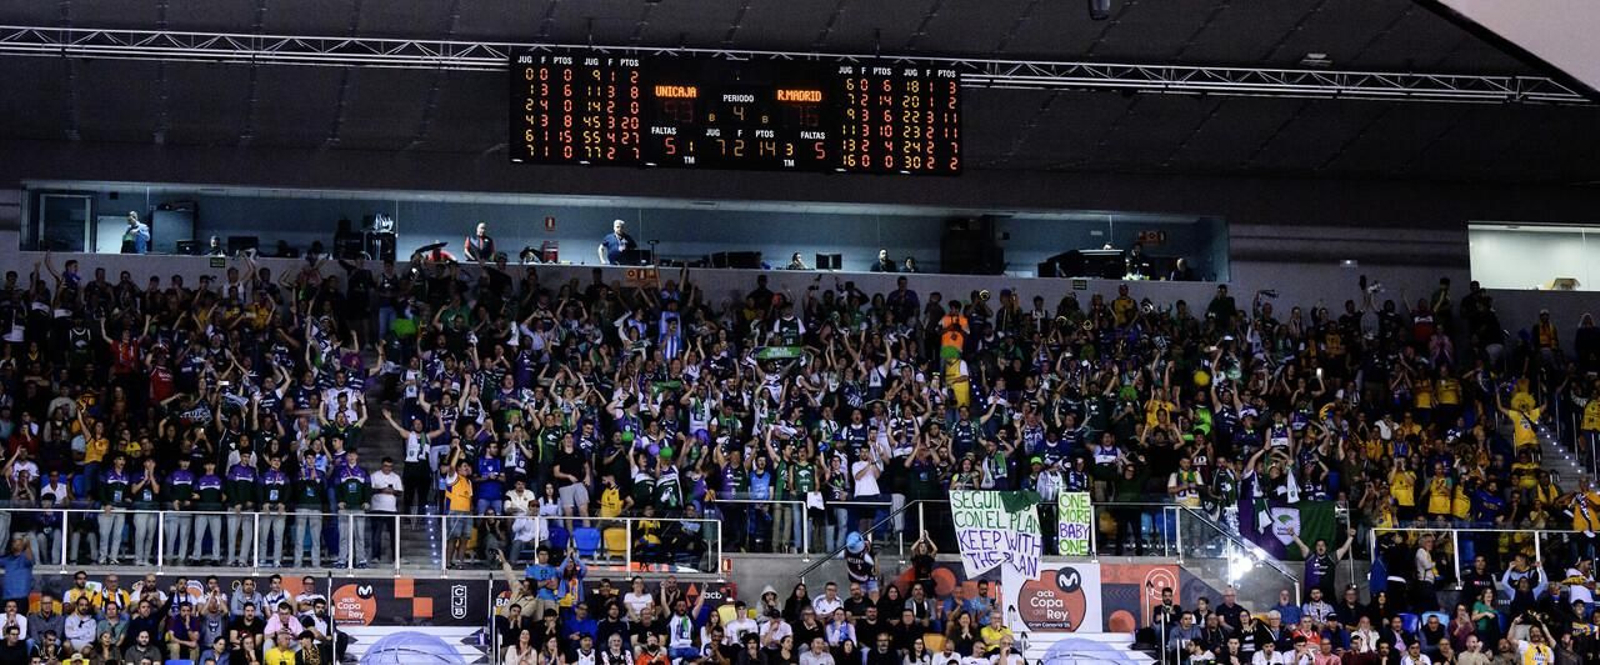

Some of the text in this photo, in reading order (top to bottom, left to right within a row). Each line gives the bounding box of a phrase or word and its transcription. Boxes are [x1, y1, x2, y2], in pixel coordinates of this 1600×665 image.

[541, 56, 546, 64] F
[553, 57, 573, 65] PTOS
[608, 58, 613, 66] F
[526, 68, 534, 80] 0
[540, 68, 548, 80] 0
[564, 69, 572, 81] 0
[592, 69, 600, 81] 9
[631, 71, 639, 83] 2
[838, 66, 853, 74] JUG
[873, 67, 892, 75] PTOS
[938, 69, 957, 77] PTOS
[541, 83, 548, 96] 3
[564, 84, 572, 96] 6
[588, 85, 600, 96] 11
[608, 85, 615, 98] 3
[631, 86, 639, 99] 8
[655, 85, 697, 98] UNICAJA
[846, 78, 854, 90] 6
[860, 78, 868, 90] 0
[883, 79, 892, 91] 6
[906, 80, 920, 92] 18
[949, 81, 956, 94] 3
[723, 94, 755, 103] PERIODO
[777, 89, 822, 101] R.MADRID
[848, 93, 855, 104] 7
[860, 93, 869, 106] 2
[879, 95, 892, 106] 14
[902, 95, 920, 107] 20
[949, 97, 957, 109] 2
[526, 98, 639, 114] 2 4 0 14 2 0
[733, 106, 744, 120] 4
[526, 114, 639, 129] 4 3 8 45 3 20
[847, 108, 957, 123] 9 3 6 22 3 11
[526, 129, 534, 141] 6
[559, 130, 572, 143] 15
[583, 131, 600, 143] 55
[607, 132, 615, 143] 4
[621, 132, 639, 144] 27
[651, 126, 677, 135] FALTAS
[705, 128, 721, 136] JUG
[755, 130, 774, 138] PTOS
[801, 131, 826, 139] FALTAS
[843, 124, 957, 139] 11 3 10 23 2 11
[527, 144, 534, 156] 7
[564, 146, 572, 158] 0
[584, 146, 600, 157] 77
[607, 147, 615, 159] 2
[632, 147, 639, 159] 7
[665, 137, 676, 154] 5
[716, 139, 776, 156] 7 2 14
[785, 143, 793, 155] 3
[814, 142, 826, 159] 5
[843, 139, 958, 154] 13 2 4 24 2 7
[684, 156, 695, 164] TM
[783, 159, 795, 167] TM
[843, 154, 958, 169] 16 0 0 30 2 2
[1060, 494, 1090, 508] ONE
[954, 510, 1042, 533] CON EL PLAN
[1059, 509, 1090, 523] MORE
[1060, 523, 1090, 539] BABY
[957, 530, 1043, 557] KEEP WITH
[1059, 539, 1088, 554] ONE
[964, 551, 1037, 577] THE PLAN
[337, 602, 361, 610] Copa
[1030, 597, 1063, 608] Copa
[349, 610, 365, 619] Rey
[1047, 609, 1069, 621] Rey
